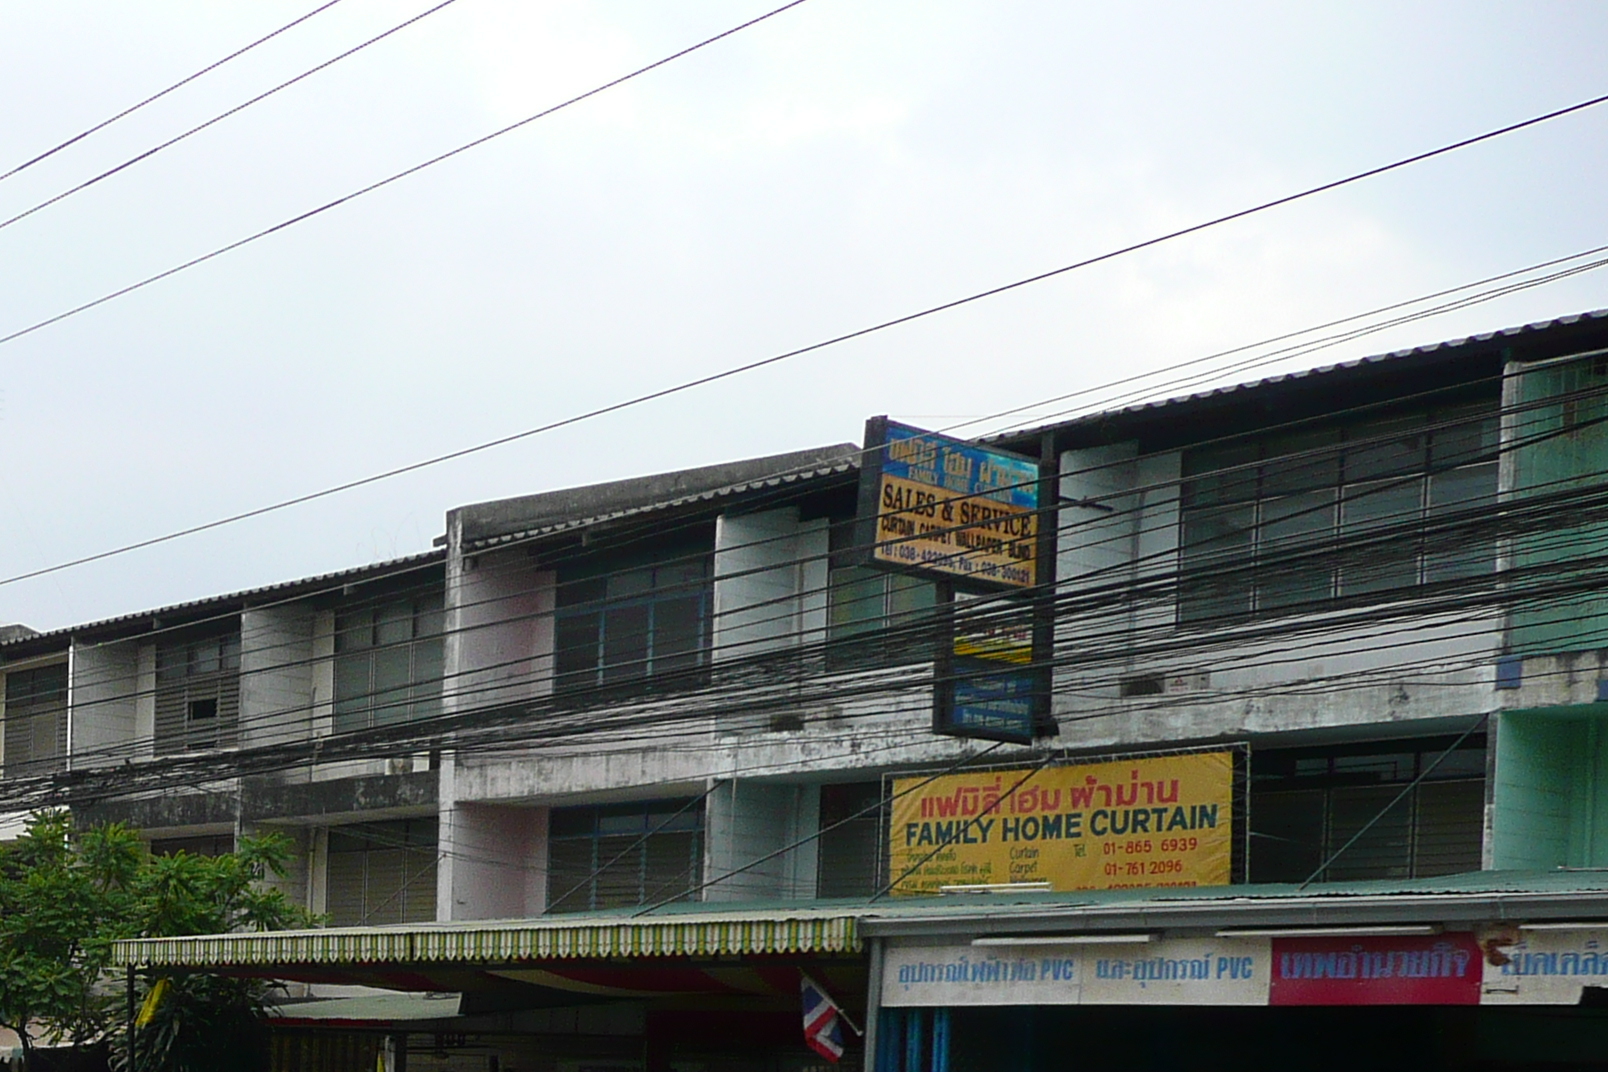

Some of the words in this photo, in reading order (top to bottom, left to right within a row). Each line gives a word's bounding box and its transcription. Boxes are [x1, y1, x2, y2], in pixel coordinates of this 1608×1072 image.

[909, 466, 939, 485] FAMILY
[883, 482, 936, 518] SALES
[942, 496, 954, 522] &
[960, 500, 1032, 537] SERVICE
[881, 517, 915, 534] CURTAIN
[919, 523, 952, 546] CARPET
[955, 530, 1004, 556] WALLPAPER
[1008, 543, 1031, 560] BLIND
[920, 774, 1003, 820] แฟมิลี่
[1009, 783, 1062, 814] โฮม
[1071, 769, 1181, 810] ผ้าม่าน
[905, 818, 996, 846] FAMILY
[1002, 812, 1083, 842] HOME
[1090, 803, 1219, 837] CURTAIN
[1009, 845, 1040, 859] Curtain
[1102, 839, 1153, 855] 01-865
[1160, 837, 1198, 852] 6939
[1008, 860, 1038, 874] Carpet
[1104, 862, 1145, 876] 01-761
[1148, 859, 1183, 875] 2096
[1041, 957, 1074, 983] PVC
[1096, 952, 1215, 988] และอุปกรณ์
[1216, 956, 1254, 981] PVC
[1280, 941, 1472, 980] เทพอำนวยกิจ
